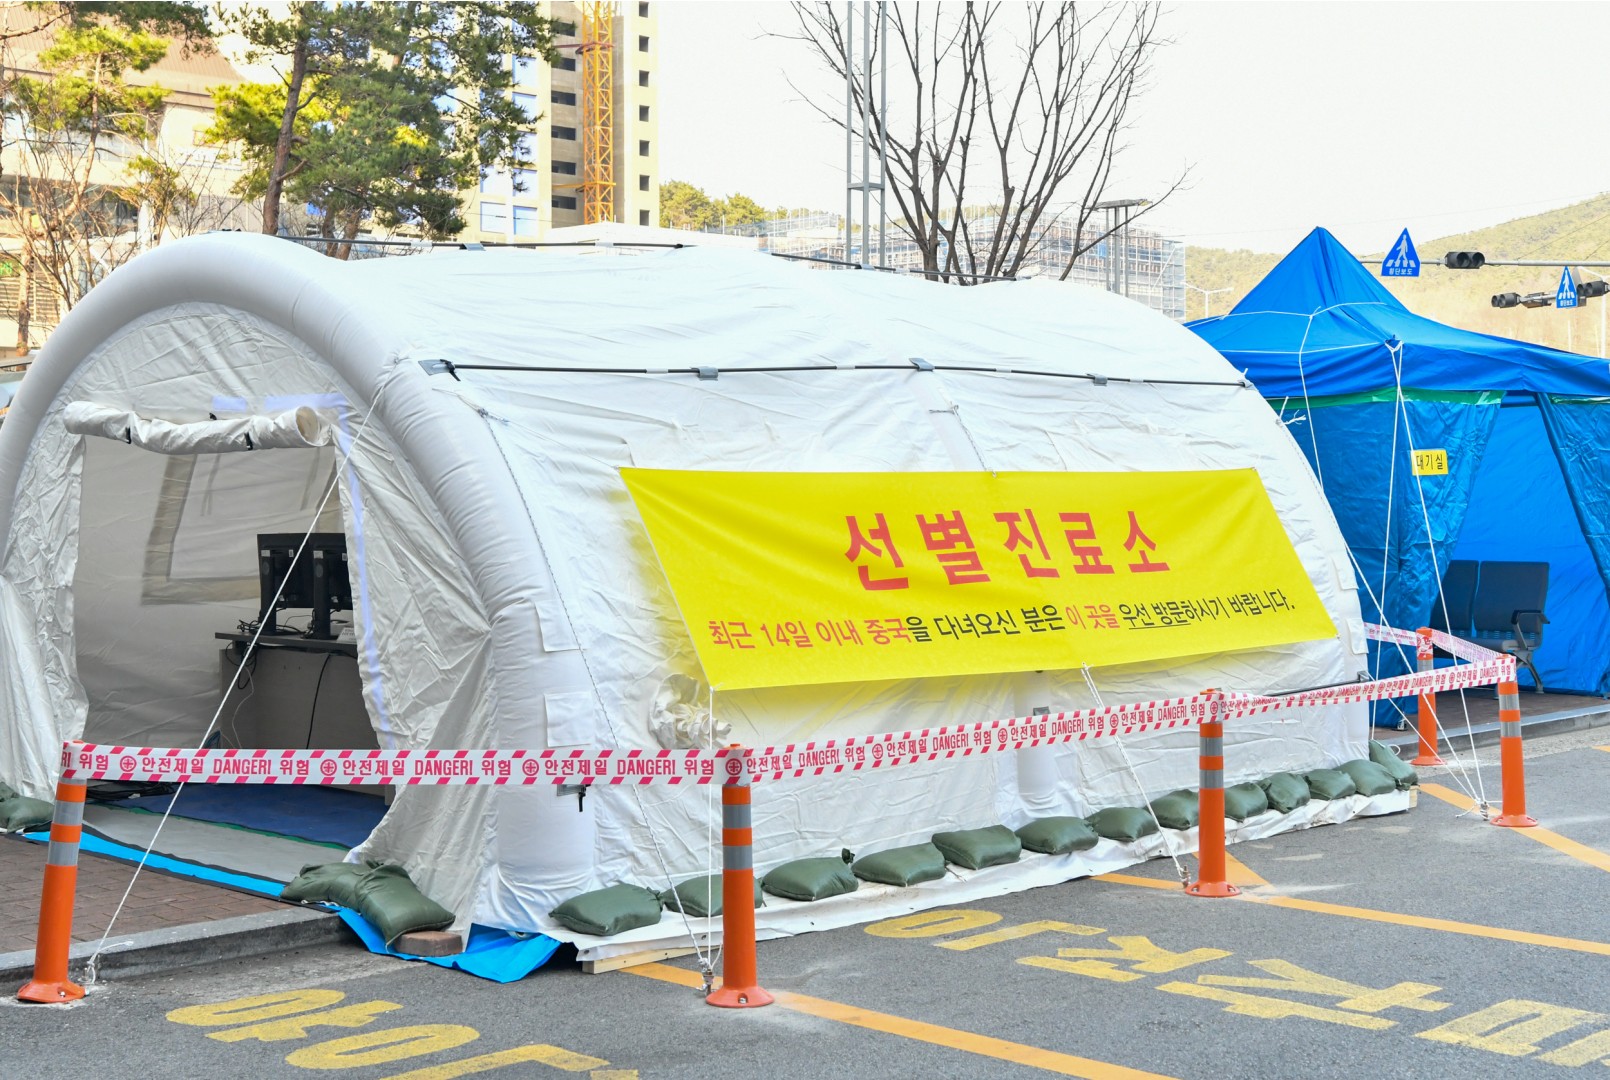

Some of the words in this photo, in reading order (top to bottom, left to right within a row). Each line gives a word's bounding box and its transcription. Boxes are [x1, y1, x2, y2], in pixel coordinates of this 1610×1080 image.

[1416, 454, 1443, 470] 대기실
[844, 508, 1171, 591] 선별진료소
[708, 620, 756, 649] 최근
[760, 620, 814, 649] 14일
[815, 619, 864, 646] 이내
[864, 616, 933, 645] 중국을
[933, 609, 1021, 640] 다녀오신
[1020, 604, 1066, 633] 분은
[1083, 604, 1121, 629] 곳을
[1118, 602, 1155, 628] 우선
[1151, 596, 1230, 626] 방문하시기
[1226, 588, 1296, 617] 바랍니다.
[79, 753, 109, 770] 위험
[141, 757, 204, 774] 안전제일
[213, 758, 271, 775] DANGER!
[279, 759, 309, 775] 위험
[342, 759, 405, 776] 안전제일
[414, 759, 473, 776] DANGER!
[481, 759, 511, 776] 위험
[544, 758, 607, 776] 안전제일
[617, 758, 676, 776] DANGER!
[684, 759, 715, 776] 위험
[747, 754, 793, 774] 안전제일
[798, 747, 840, 767] DANGER!
[844, 745, 866, 763] 위험
[887, 737, 927, 758] 안전제일
[932, 732, 969, 752] DANGER!
[973, 729, 992, 747] 위험
[1010, 723, 1047, 742] 안전제일
[1051, 717, 1085, 736] DANGER!
[1087, 715, 1105, 731] 위험
[1121, 710, 1153, 727] 안전제일
[1157, 704, 1188, 721] DANGER!
[1190, 702, 1206, 717] 위험
